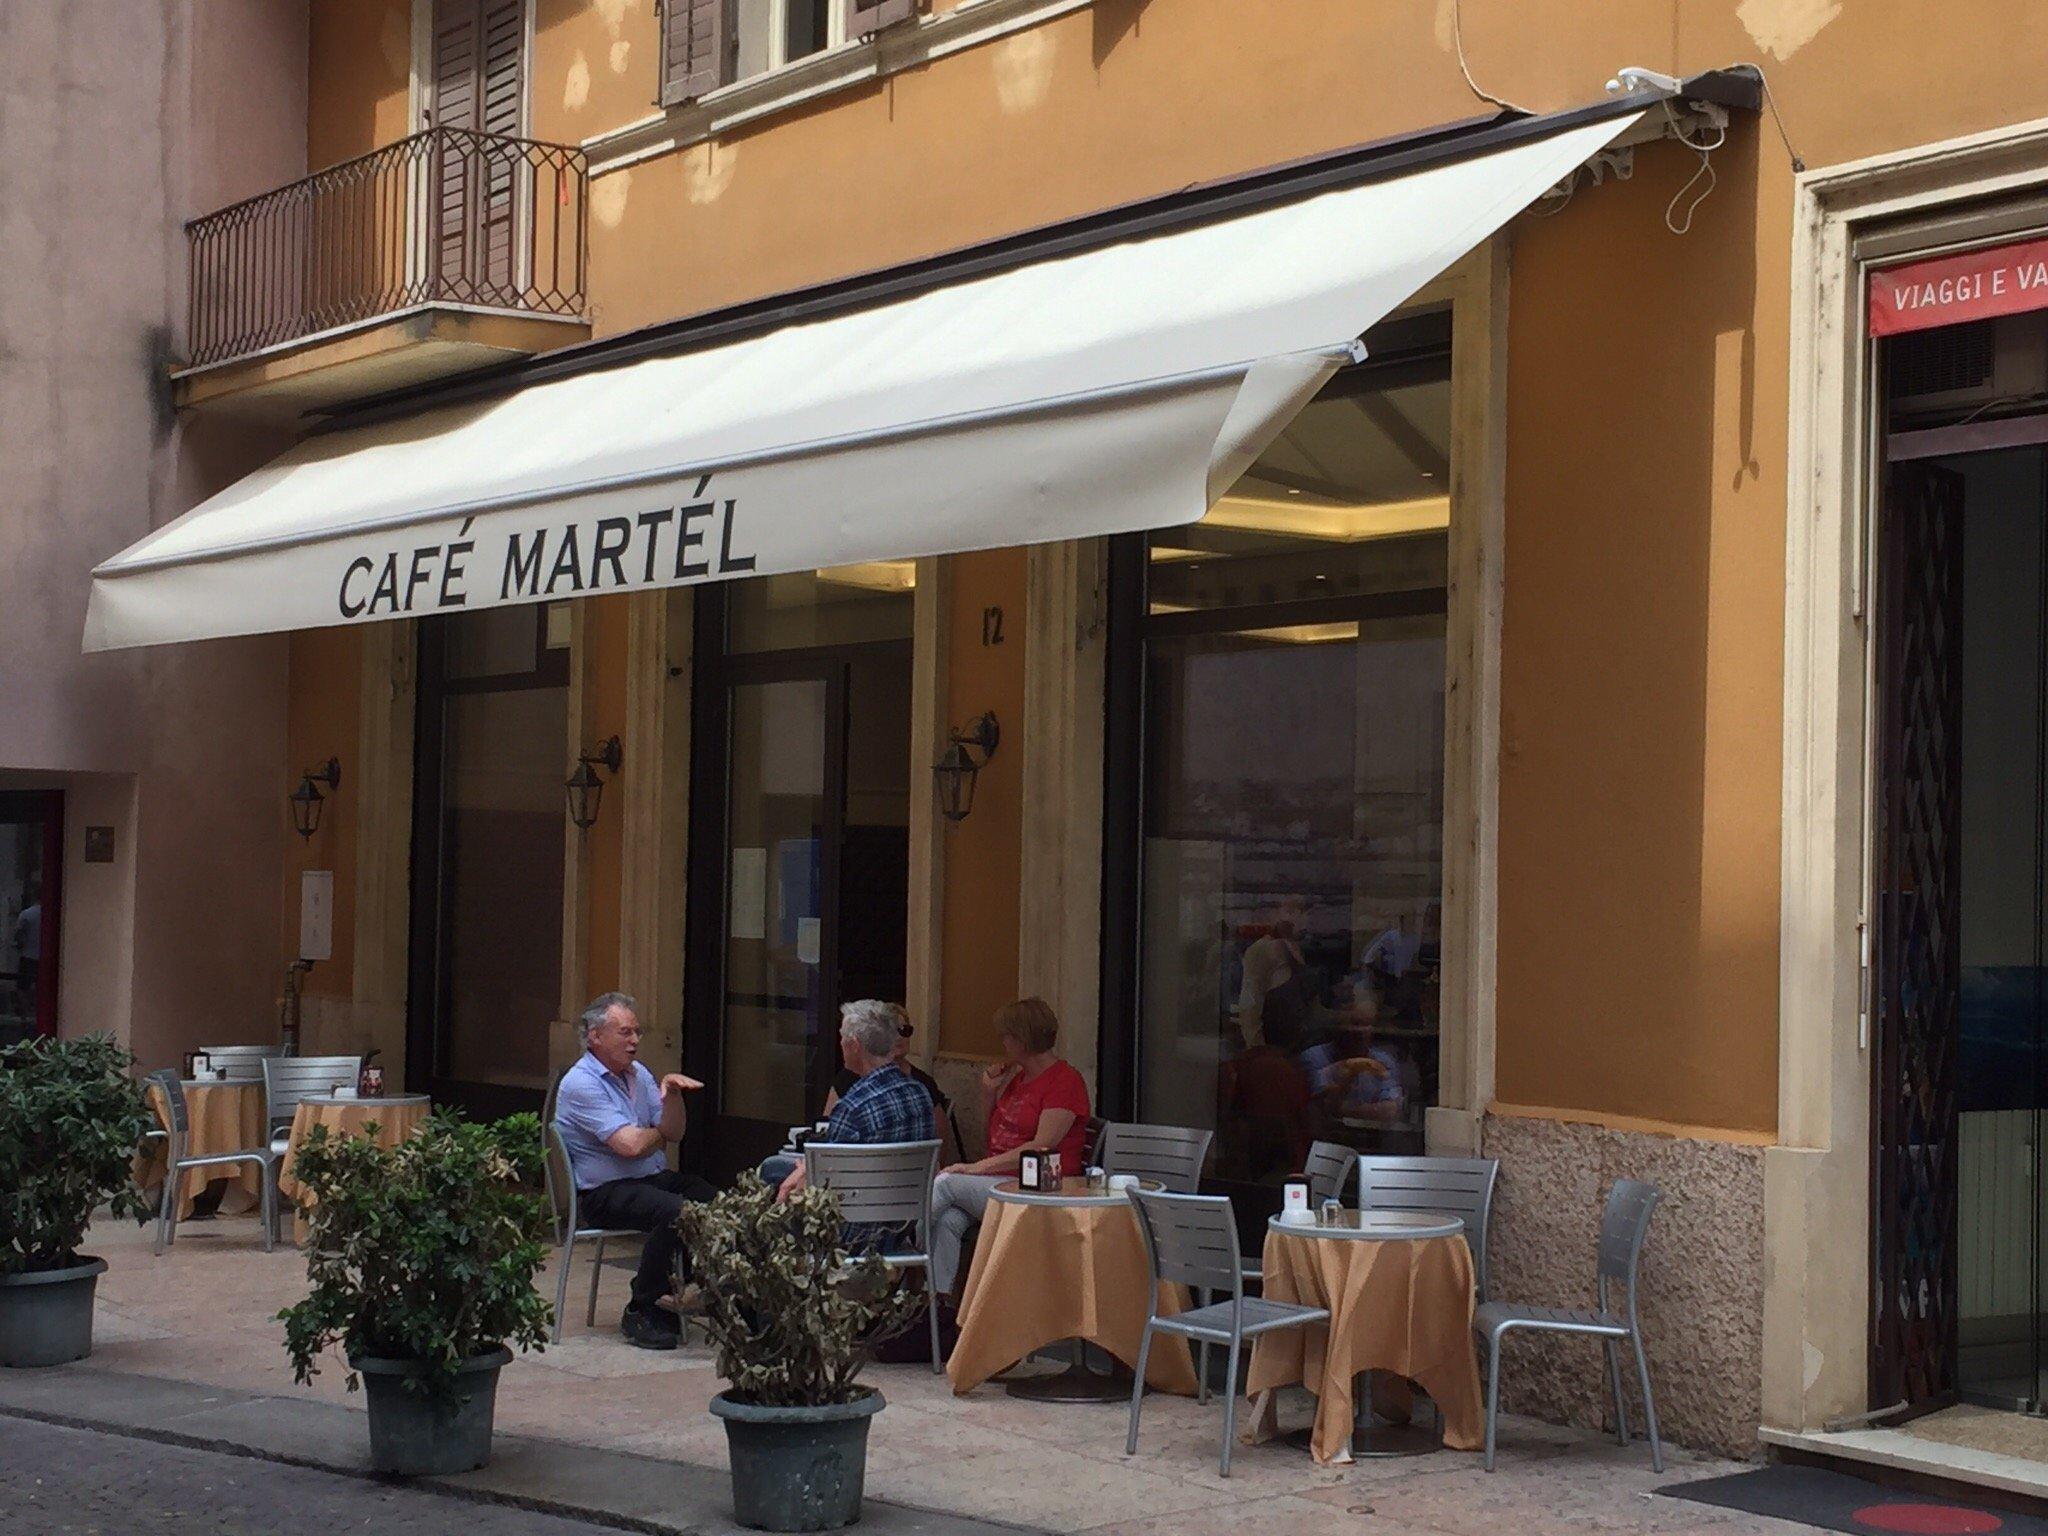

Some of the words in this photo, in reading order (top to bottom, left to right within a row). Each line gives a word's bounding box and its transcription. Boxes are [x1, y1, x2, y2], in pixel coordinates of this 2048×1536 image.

[1894, 273, 1982, 311] VIAGGI
[1992, 269, 2007, 296] E
[339, 516, 475, 619] CAFÉ
[500, 474, 757, 600] MARTÉL
[982, 606, 1005, 647] 12
